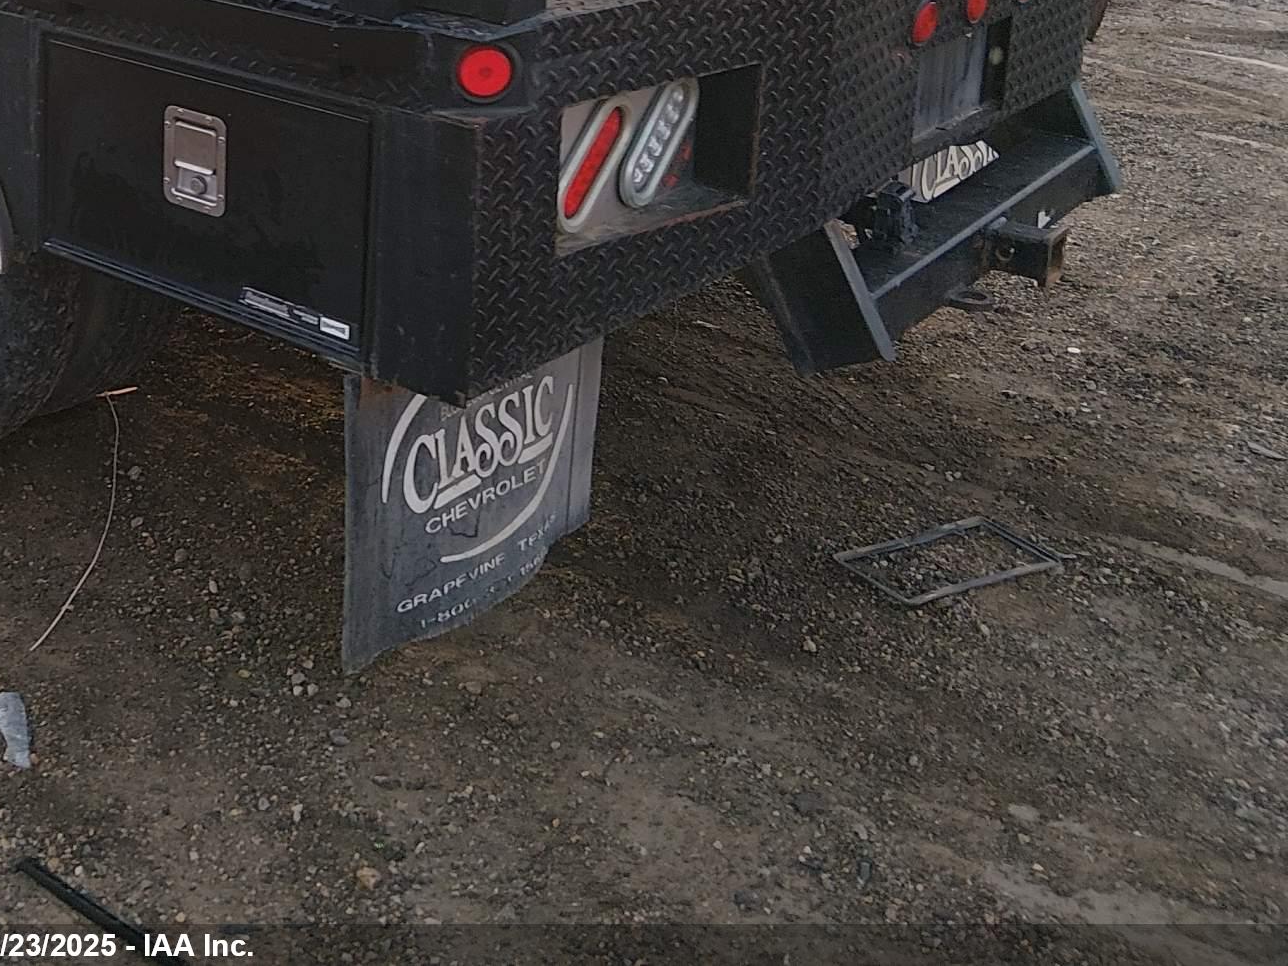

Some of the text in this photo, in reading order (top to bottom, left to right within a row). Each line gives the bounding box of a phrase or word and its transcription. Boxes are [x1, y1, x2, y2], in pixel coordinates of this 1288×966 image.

[403, 375, 553, 513] CLASSIC
[425, 458, 547, 534] CHEVROLET
[396, 552, 506, 613] GRAPEVINE
